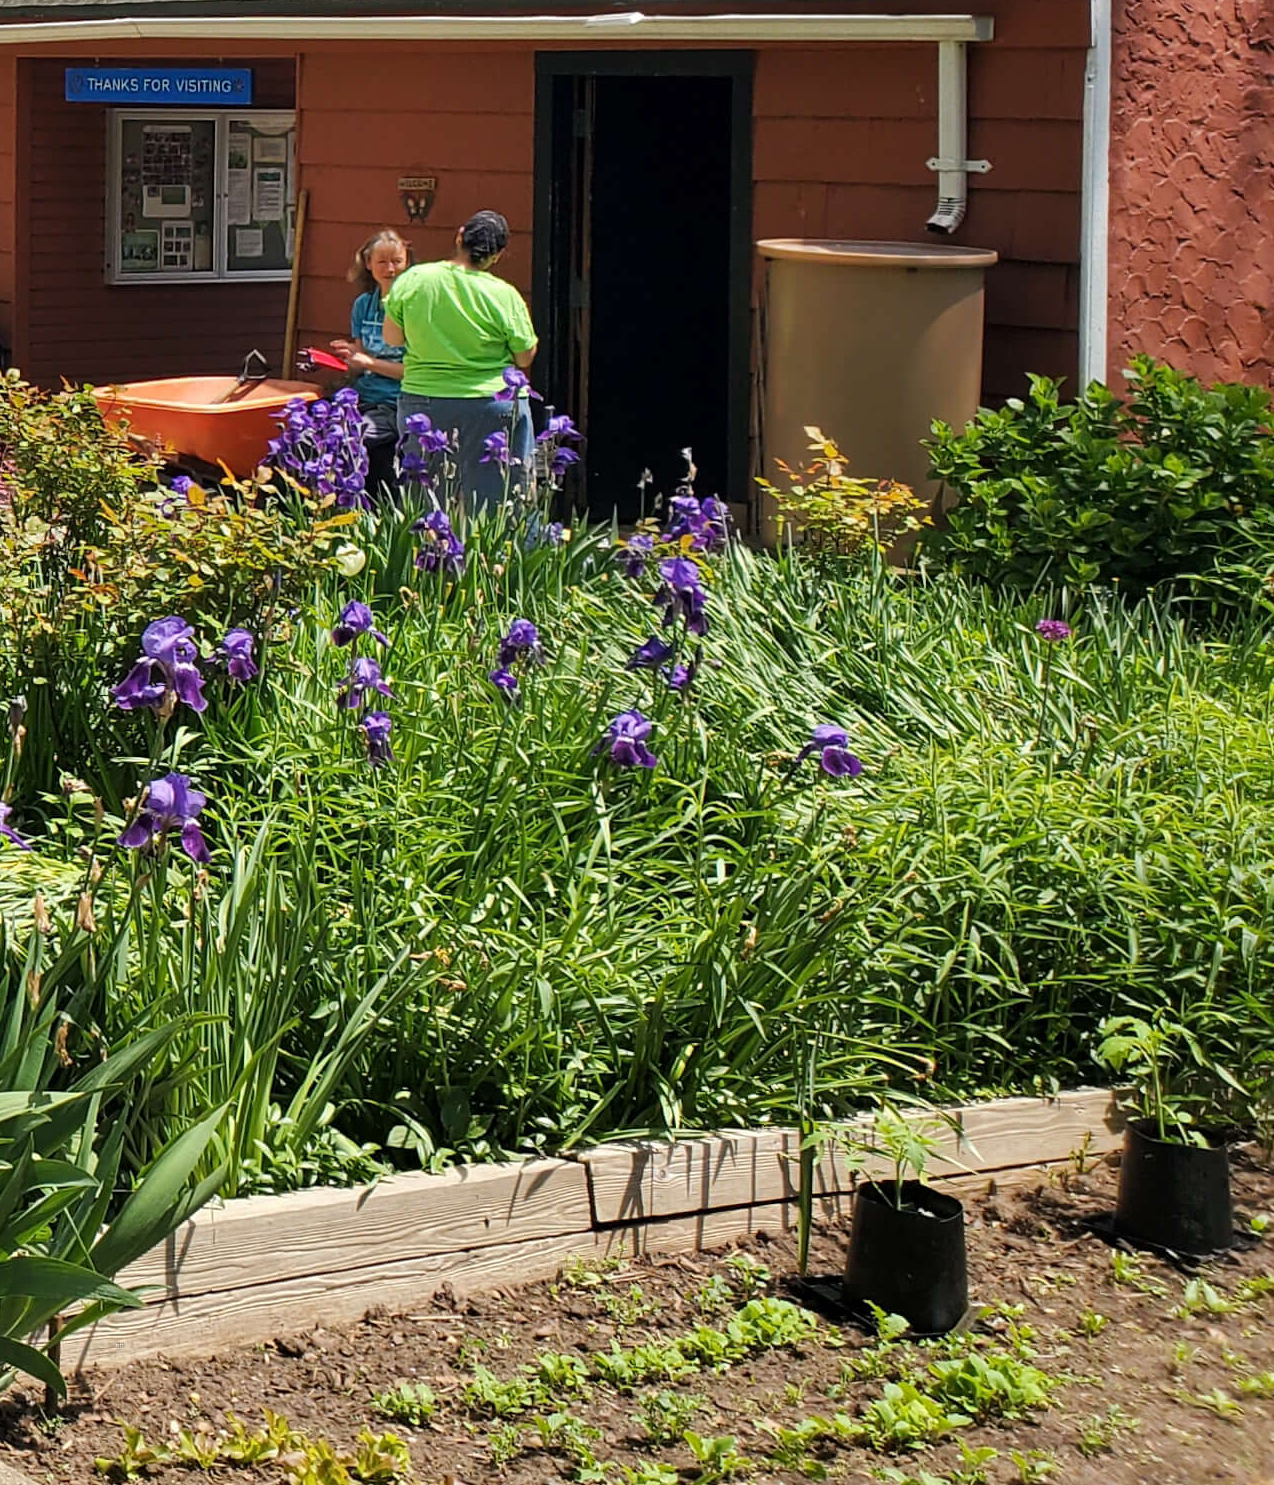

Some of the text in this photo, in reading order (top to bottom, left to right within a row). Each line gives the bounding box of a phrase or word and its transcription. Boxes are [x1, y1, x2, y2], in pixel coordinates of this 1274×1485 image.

[87, 77, 232, 93] THANKS FOR VISITING
